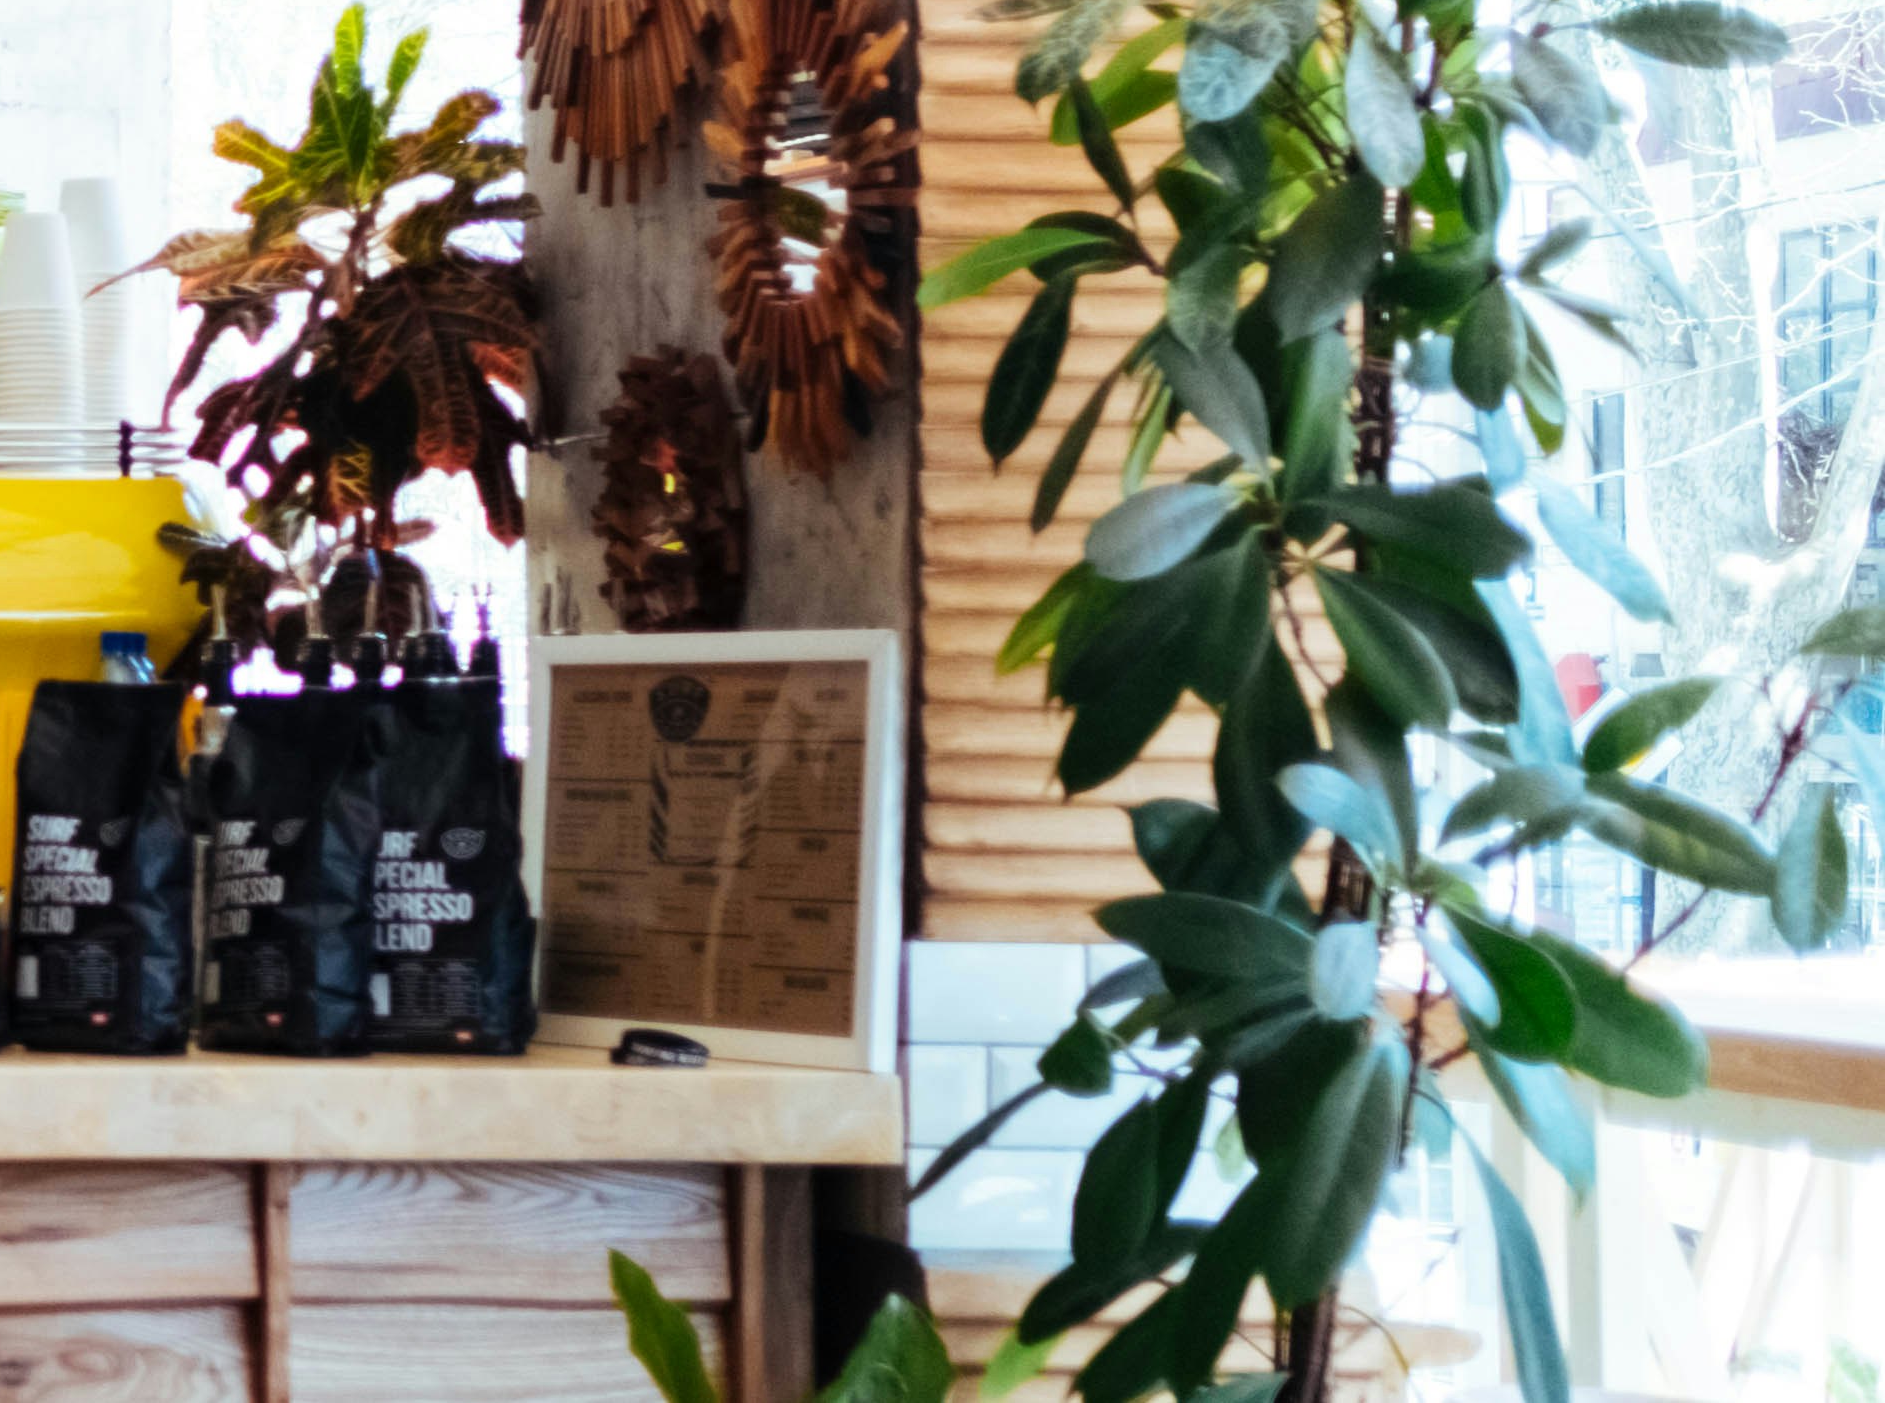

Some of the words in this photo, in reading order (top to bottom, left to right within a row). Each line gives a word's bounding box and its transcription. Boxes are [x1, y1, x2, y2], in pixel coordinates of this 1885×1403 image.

[27, 814, 81, 843] SURF
[377, 831, 419, 858] URF
[23, 845, 98, 873] SPECIAL
[374, 861, 451, 889] PECIAL
[373, 892, 474, 922] SPRESSO
[375, 923, 433, 952] LEND
